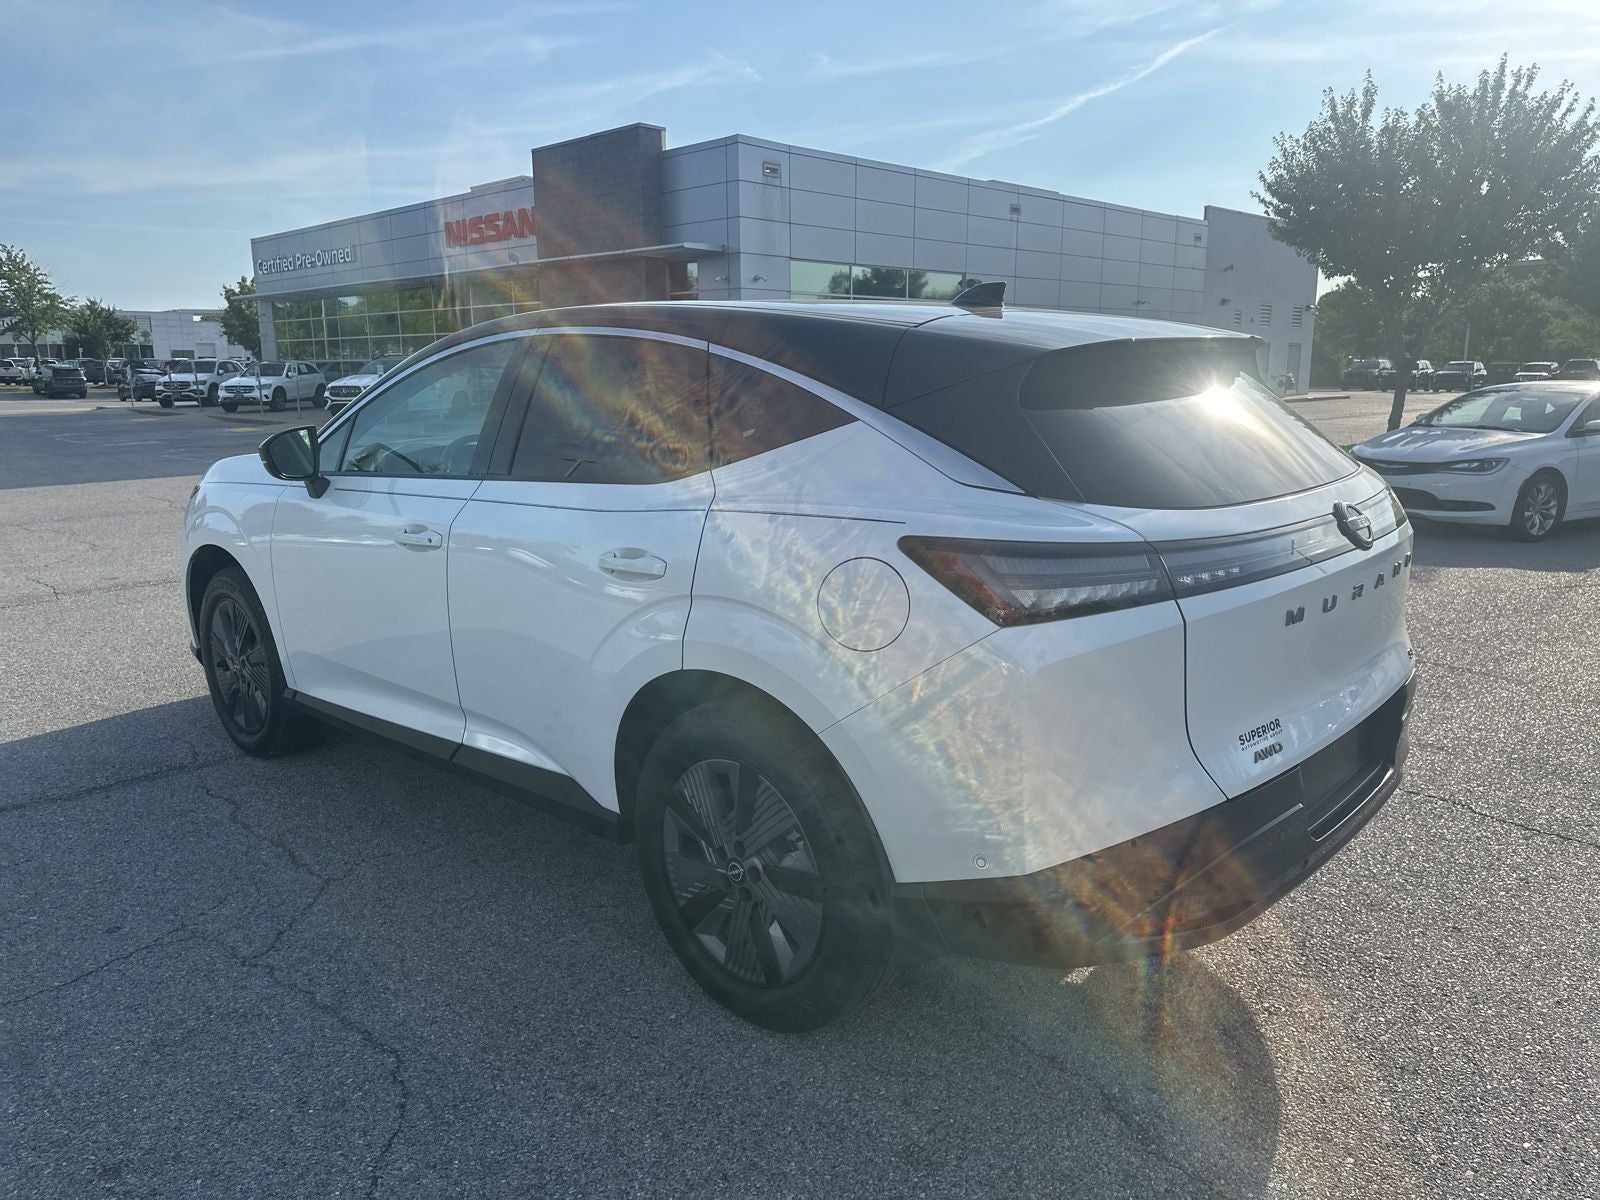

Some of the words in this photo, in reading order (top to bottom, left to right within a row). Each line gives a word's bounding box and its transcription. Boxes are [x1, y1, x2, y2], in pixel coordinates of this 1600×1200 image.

[445, 206, 536, 249] NISSAN
[257, 253, 294, 275] Certified
[294, 242, 353, 269] Pre-Owned
[1238, 718, 1282, 746] SUPERIOR
[1254, 741, 1284, 764] AWD
